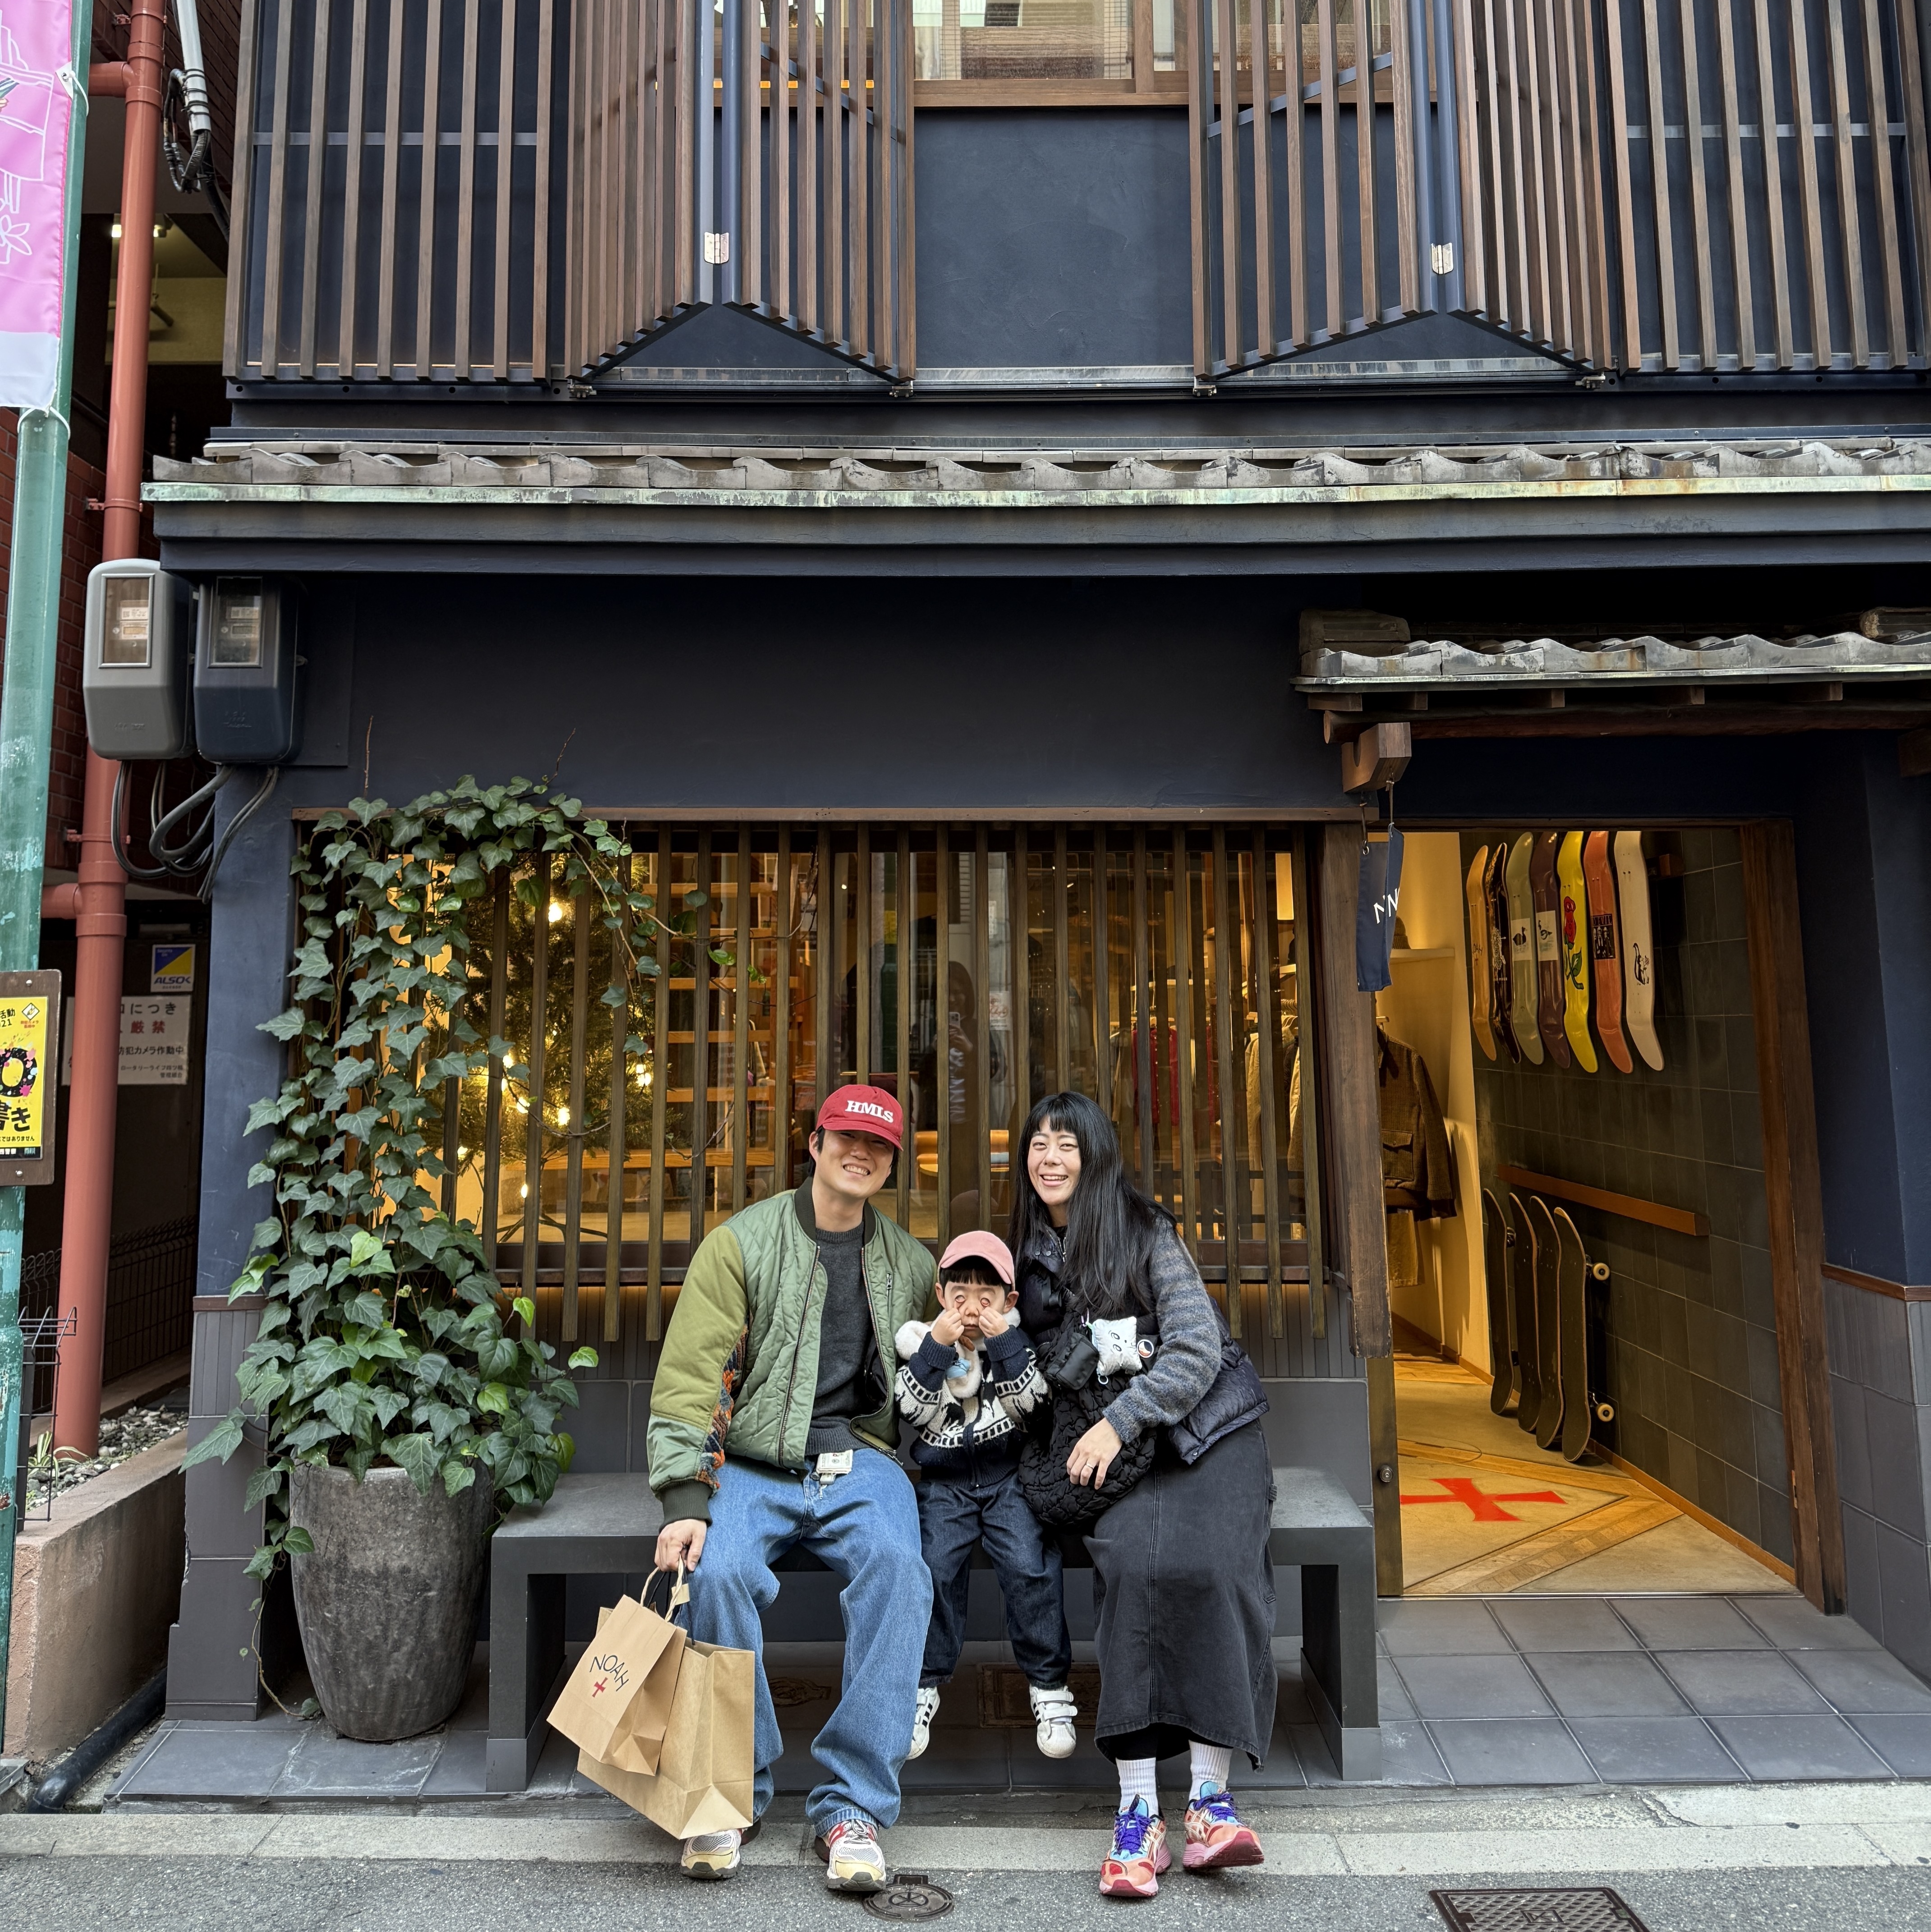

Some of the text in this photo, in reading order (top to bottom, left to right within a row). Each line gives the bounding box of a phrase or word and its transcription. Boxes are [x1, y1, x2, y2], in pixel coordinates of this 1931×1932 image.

[1472, 943, 1483, 956] OAH
[154, 976, 191, 984] ALSOK
[0, 1019, 12, 1028] 21
[119, 1020, 166, 1034] 厳禁
[589, 1654, 629, 1692] NOAH
